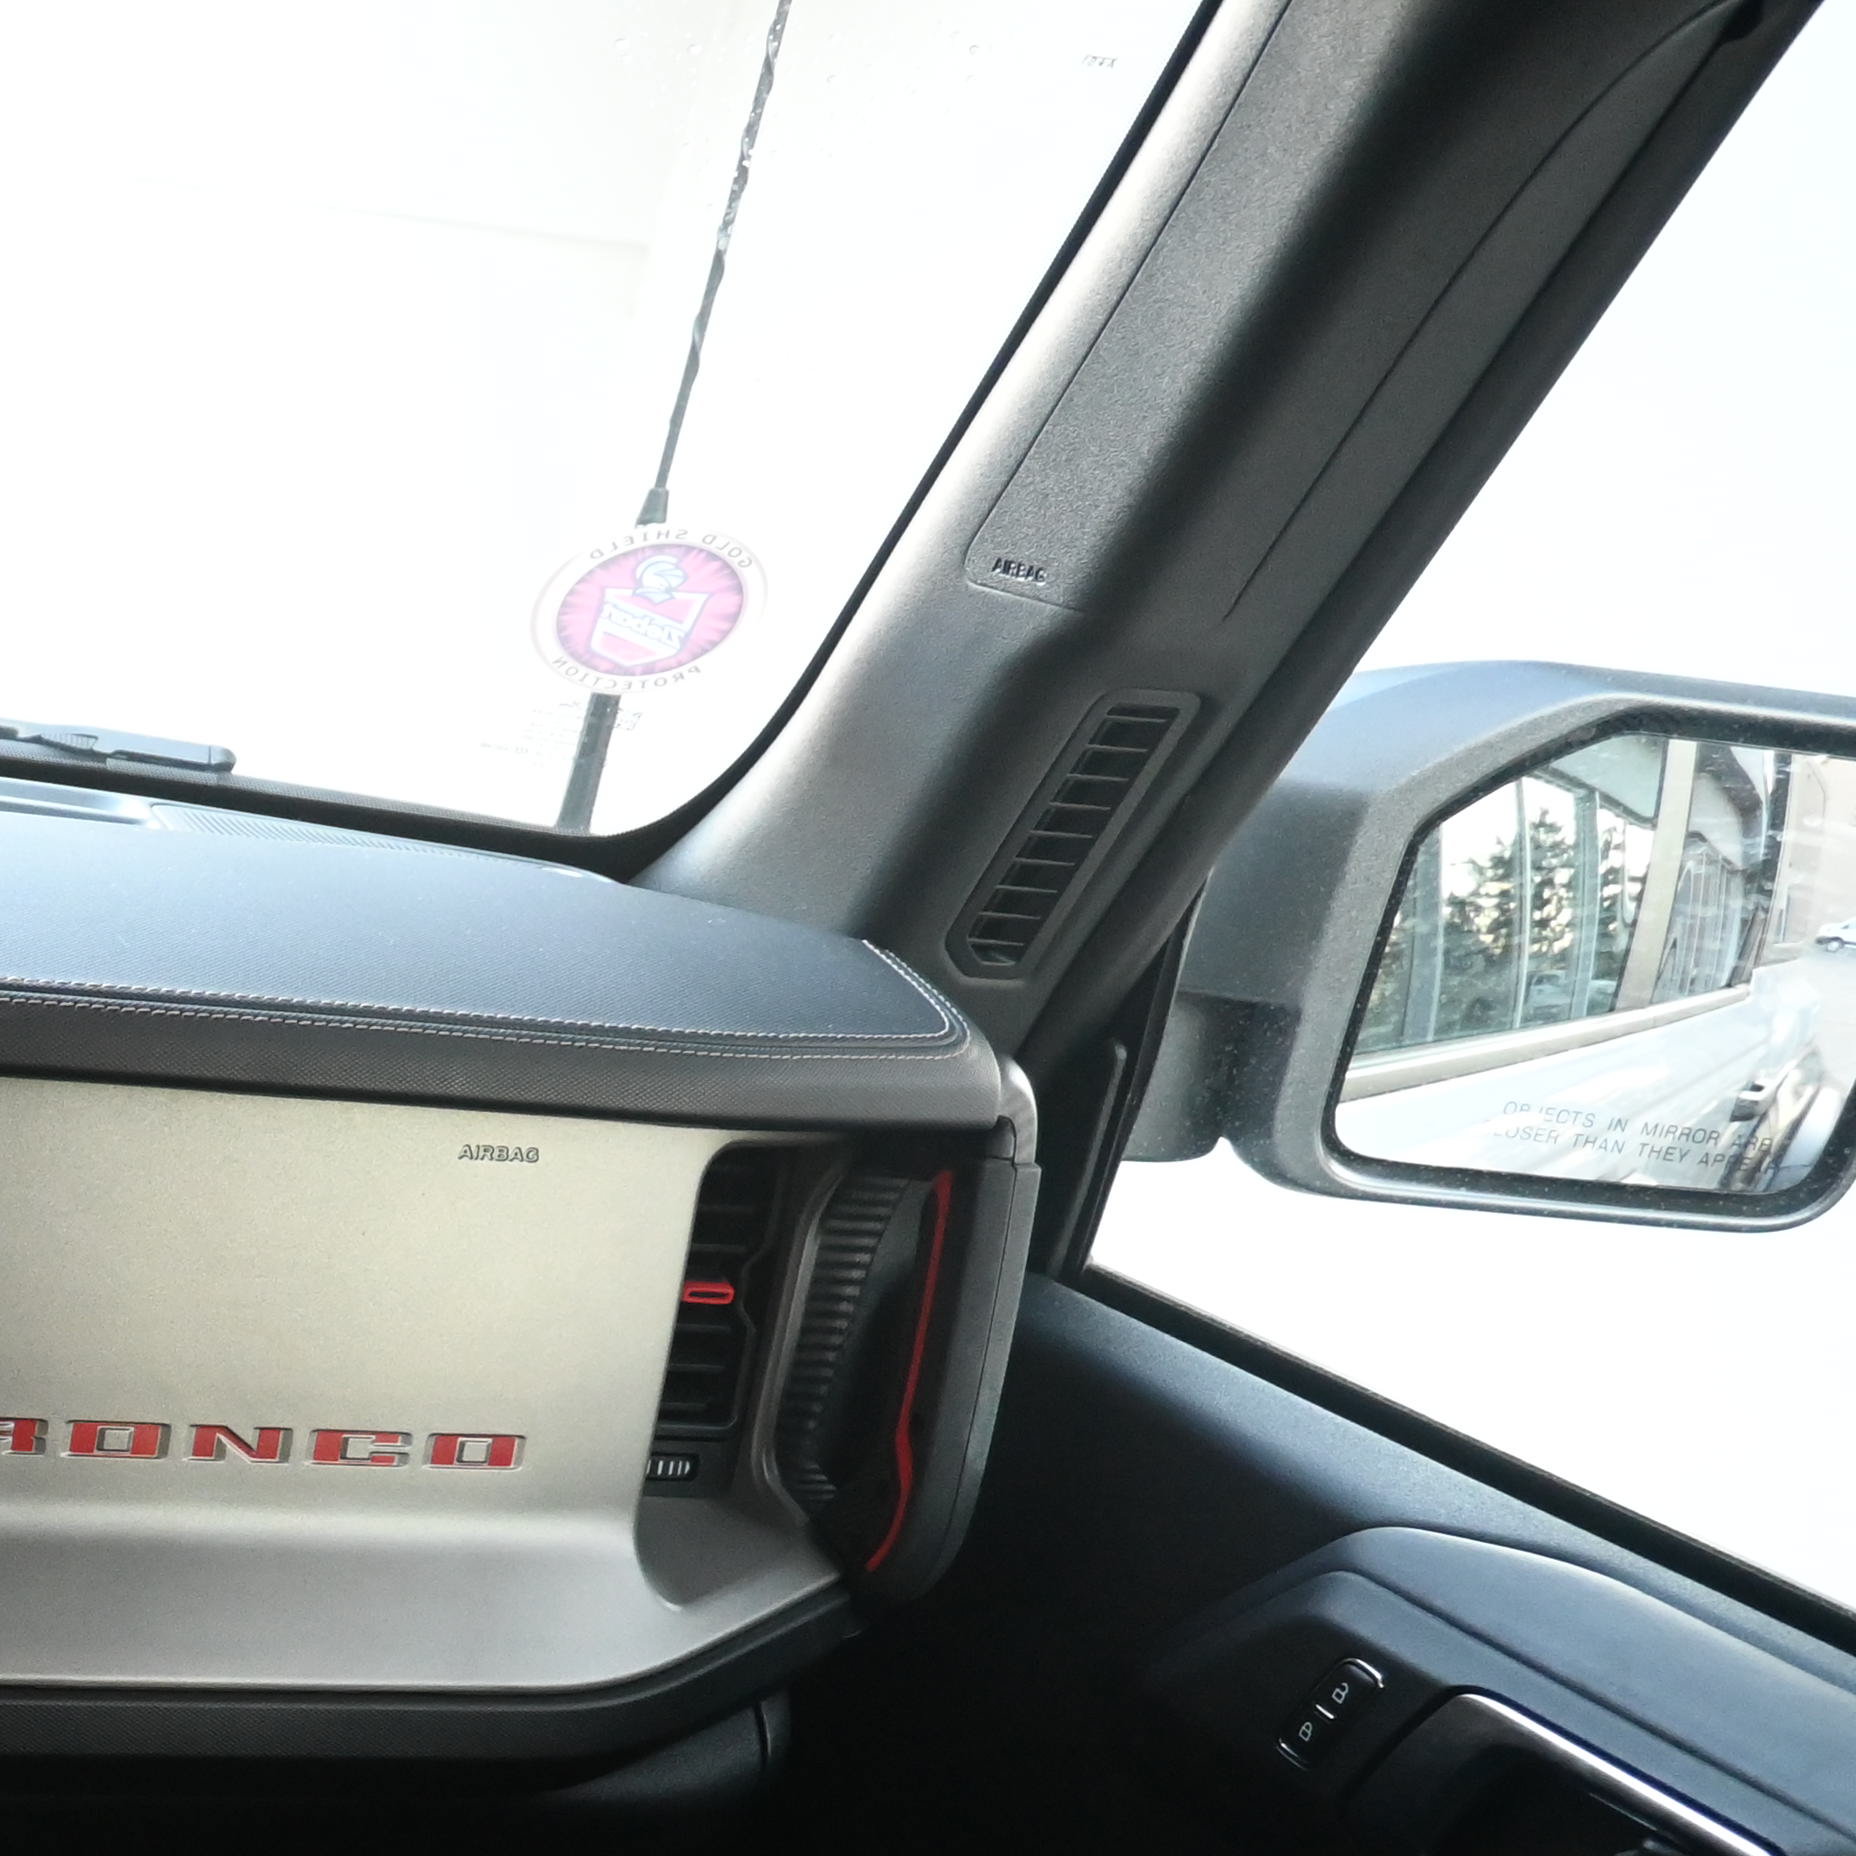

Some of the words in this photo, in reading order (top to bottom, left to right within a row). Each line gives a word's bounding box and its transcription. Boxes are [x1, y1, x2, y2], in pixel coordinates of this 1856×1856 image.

[991, 557, 1048, 583] AIRBAG
[1608, 1117, 1630, 1133] IN
[1641, 1121, 1721, 1148] MIRROR
[457, 1143, 540, 1163] AIRBAG
[1572, 1133, 1627, 1155] THAN
[1638, 1143, 1690, 1164] THEY
